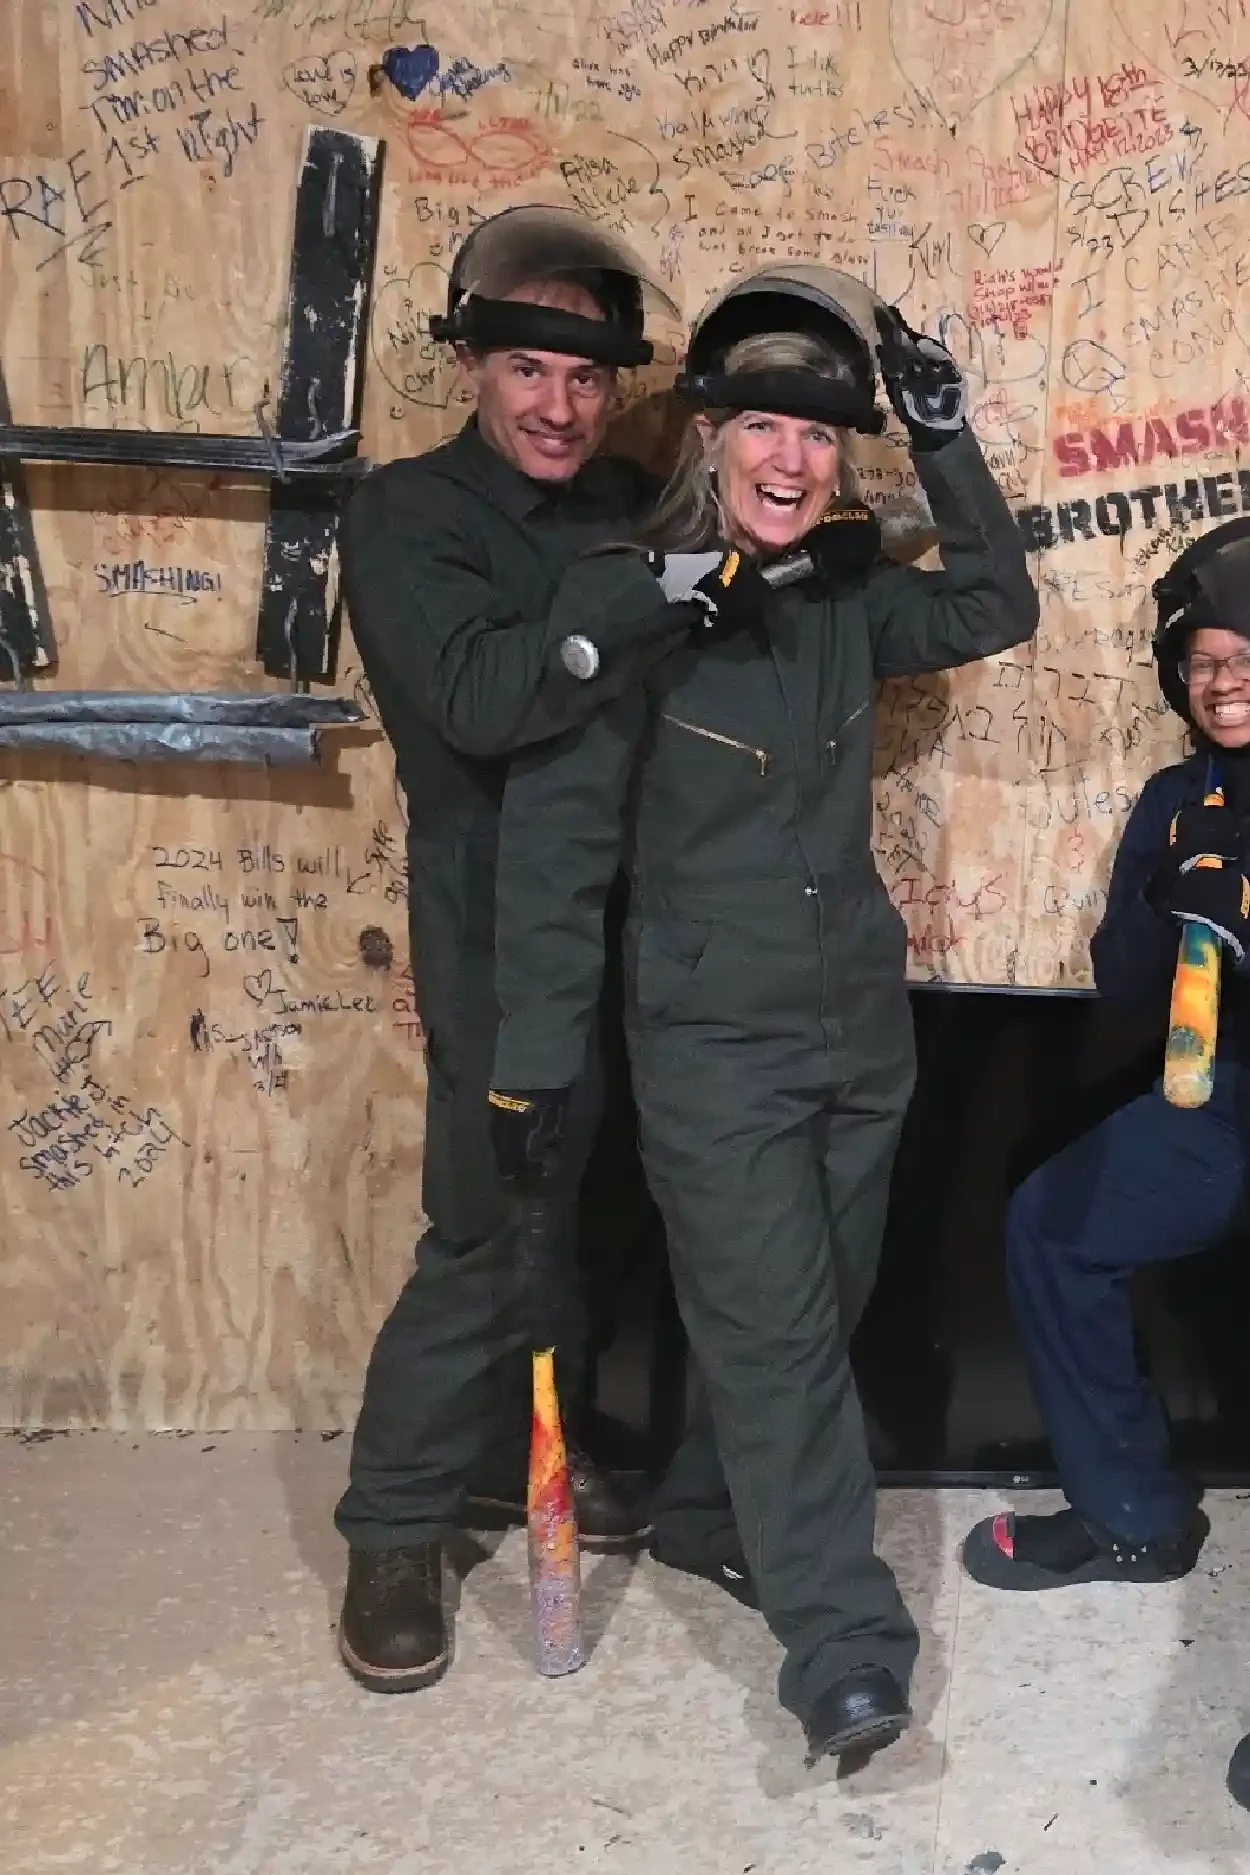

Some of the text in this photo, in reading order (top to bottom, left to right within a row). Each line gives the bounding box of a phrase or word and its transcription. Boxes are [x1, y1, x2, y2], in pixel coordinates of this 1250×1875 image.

[1054, 399, 1250, 478] SMASH
[152, 846, 224, 869] 2024
[237, 843, 286, 874] Bills
[156, 880, 329, 924] Finally win the
[136, 917, 211, 978] Big
